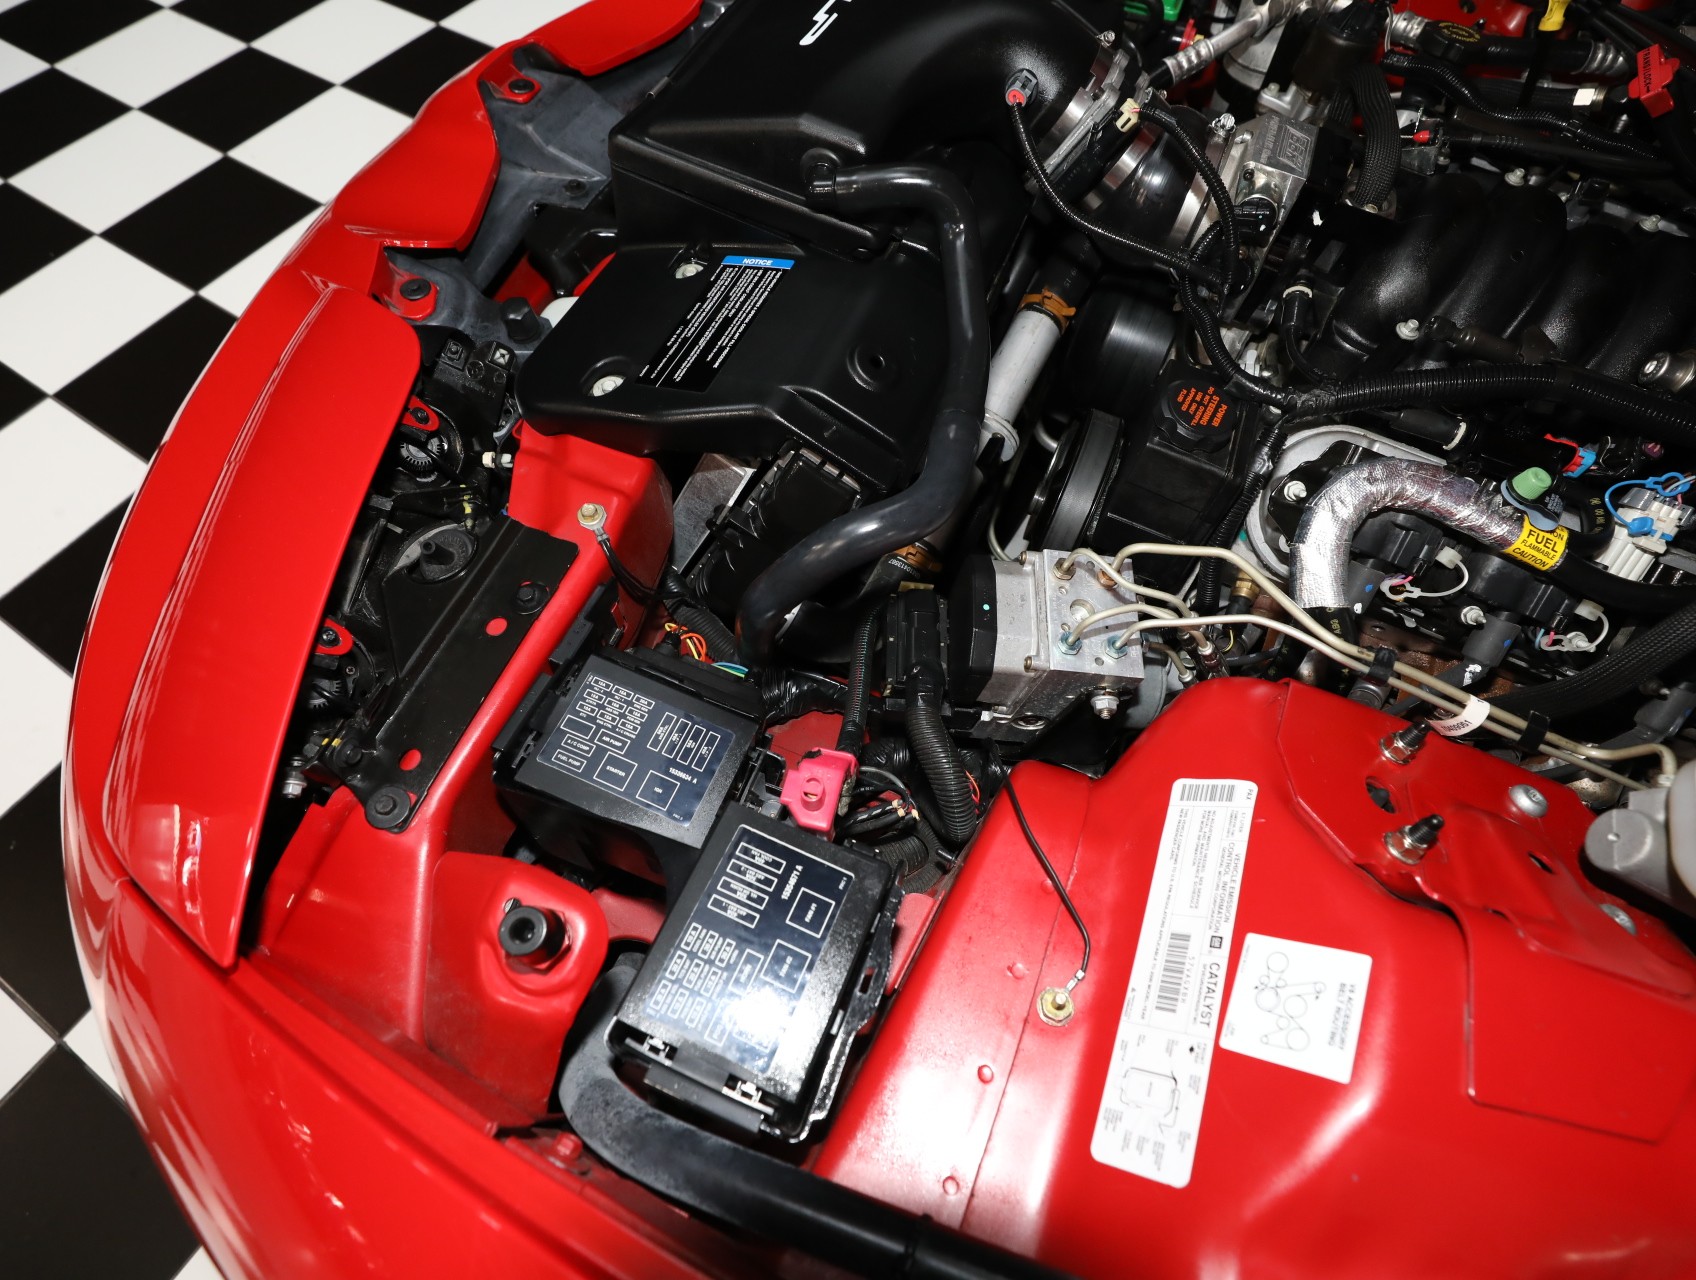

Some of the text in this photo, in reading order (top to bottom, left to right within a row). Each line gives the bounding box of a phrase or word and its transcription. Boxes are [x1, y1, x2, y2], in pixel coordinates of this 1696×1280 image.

[743, 258, 773, 266] NOTICE
[1177, 389, 1187, 402] FLUID
[1181, 388, 1196, 411] APPROVED
[1189, 392, 1203, 415] USE ONLY
[1191, 406, 1204, 426] OVERFILL
[1200, 395, 1219, 425] STEERING
[1212, 404, 1227, 427] POWER
[1521, 539, 1556, 560] FLAMMABLE
[1527, 529, 1558, 553] FUEL
[1512, 547, 1549, 568] CAUTION
[576, 743, 589, 751] COMP
[609, 738, 622, 747] PUMP
[557, 753, 580, 766] FUEL PUMP
[606, 765, 625, 776] STARTER
[1245, 788, 1253, 800] PAX
[794, 863, 803, 871] A
[1223, 841, 1234, 876] CONTROL
[1222, 853, 1241, 923] VEHICLE EMISSION
[804, 909, 814, 922] FAN
[1213, 880, 1228, 933] INFORMATION
[1197, 960, 1220, 1028] CATALYST
